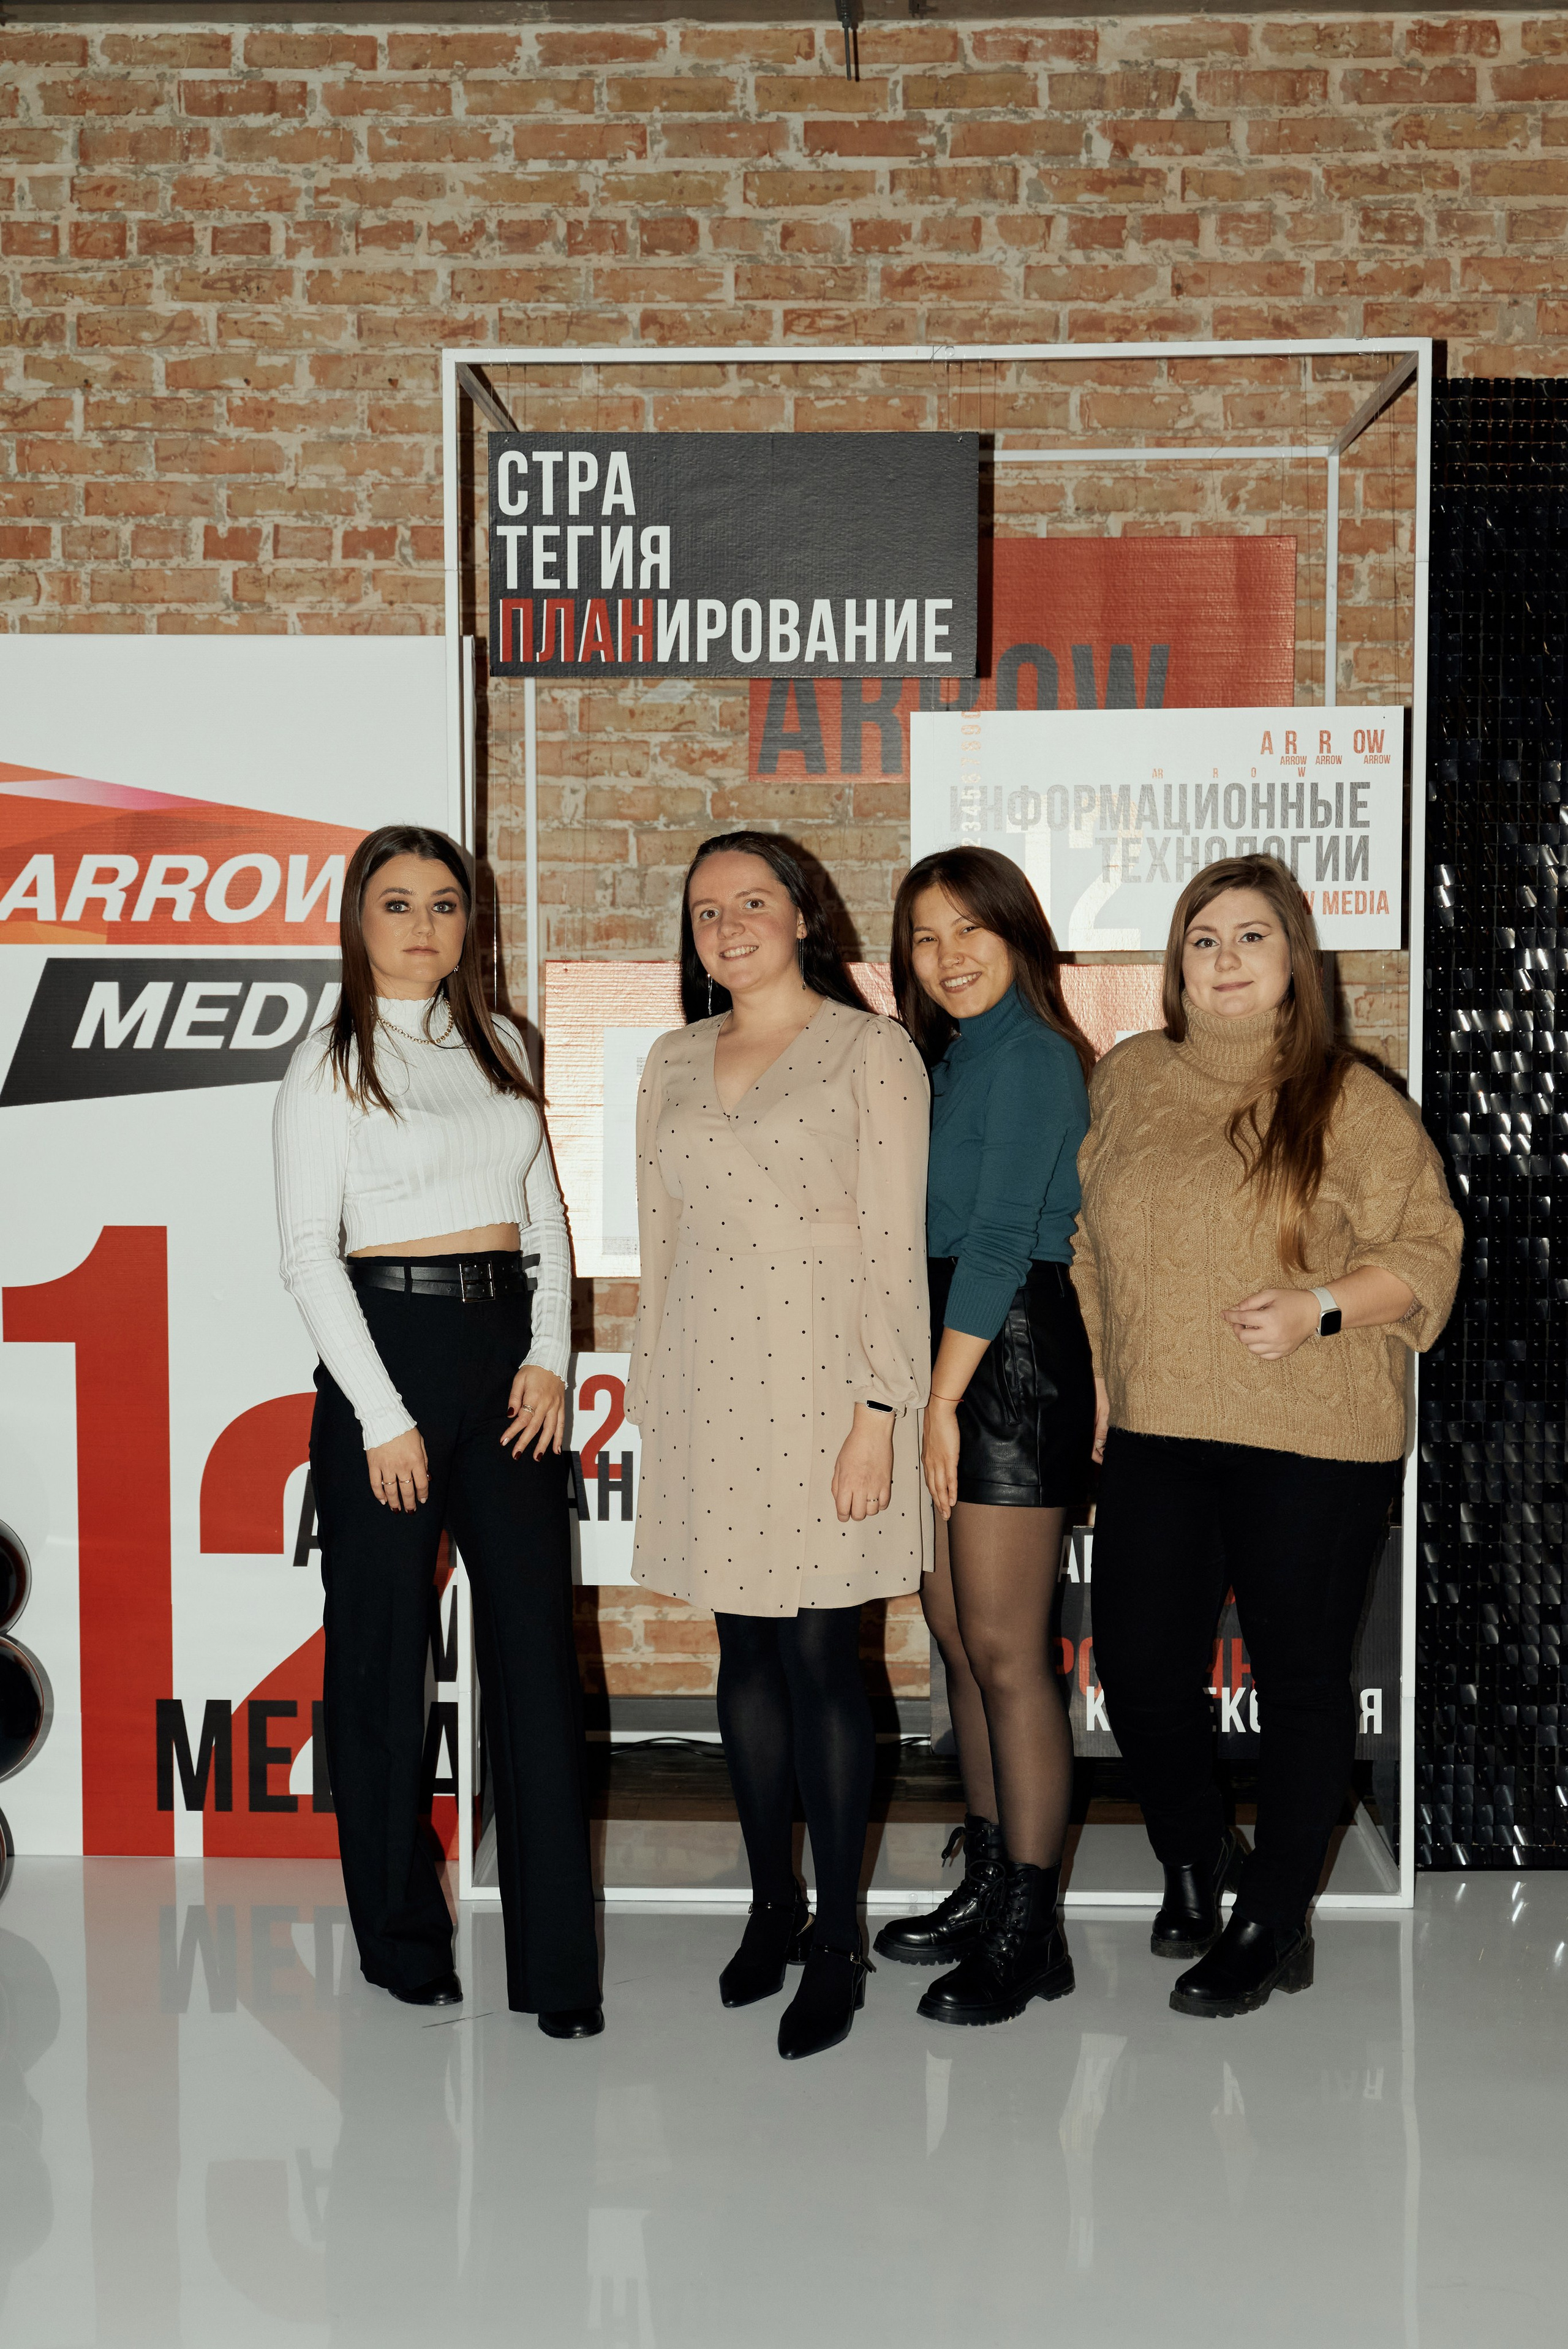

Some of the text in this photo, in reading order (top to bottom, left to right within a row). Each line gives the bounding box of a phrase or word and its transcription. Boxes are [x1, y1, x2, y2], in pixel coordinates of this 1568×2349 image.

[497, 450, 636, 516] СТРА
[497, 526, 671, 589] ТЕГИЯ
[499, 598, 952, 663] ПЛАНИРОВАНИЕ
[757, 643, 1170, 774] AROW
[1280, 755, 1391, 765] ARROW ARROW ARROW
[950, 782, 1371, 835] ИНФОРМАЦИОННЫЕ
[1322, 890, 1390, 915] MEDIA
[72, 981, 342, 1049] MEDI
